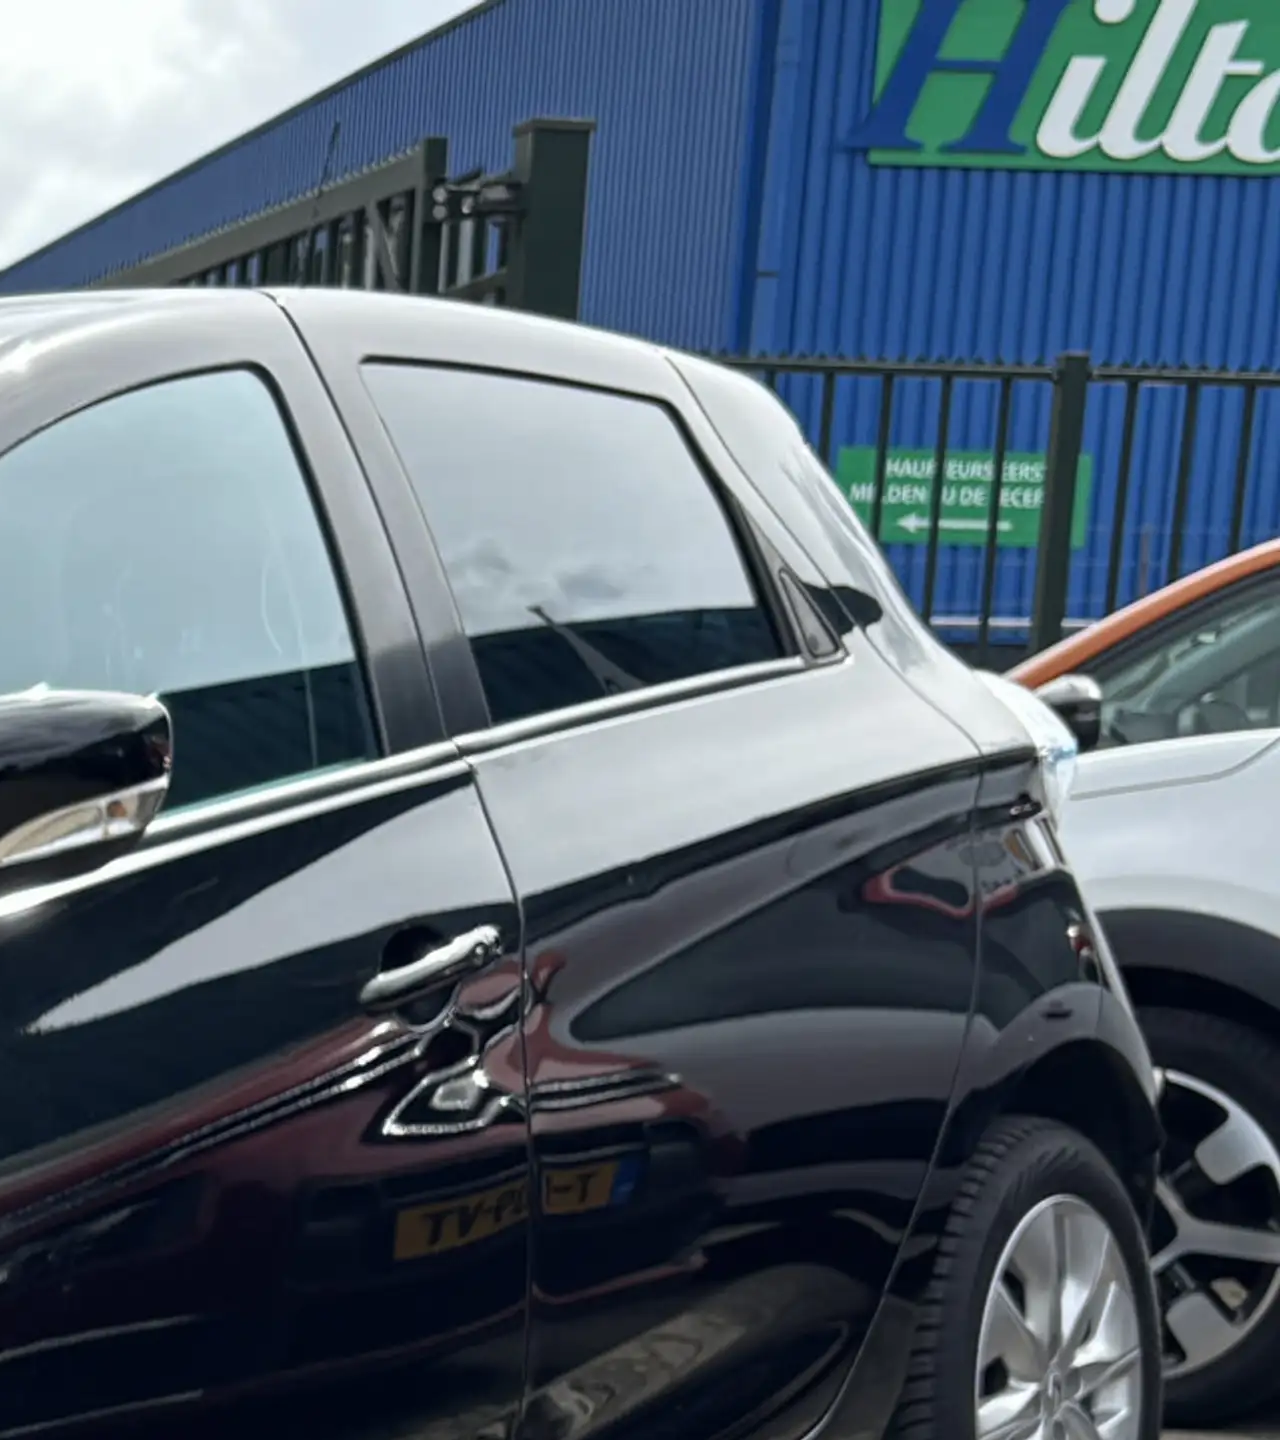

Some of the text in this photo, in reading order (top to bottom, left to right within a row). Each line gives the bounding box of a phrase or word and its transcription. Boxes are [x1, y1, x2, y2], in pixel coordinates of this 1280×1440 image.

[886, 459, 1046, 482] HAUFEURS EERS
[850, 483, 927, 504] MEDEN
